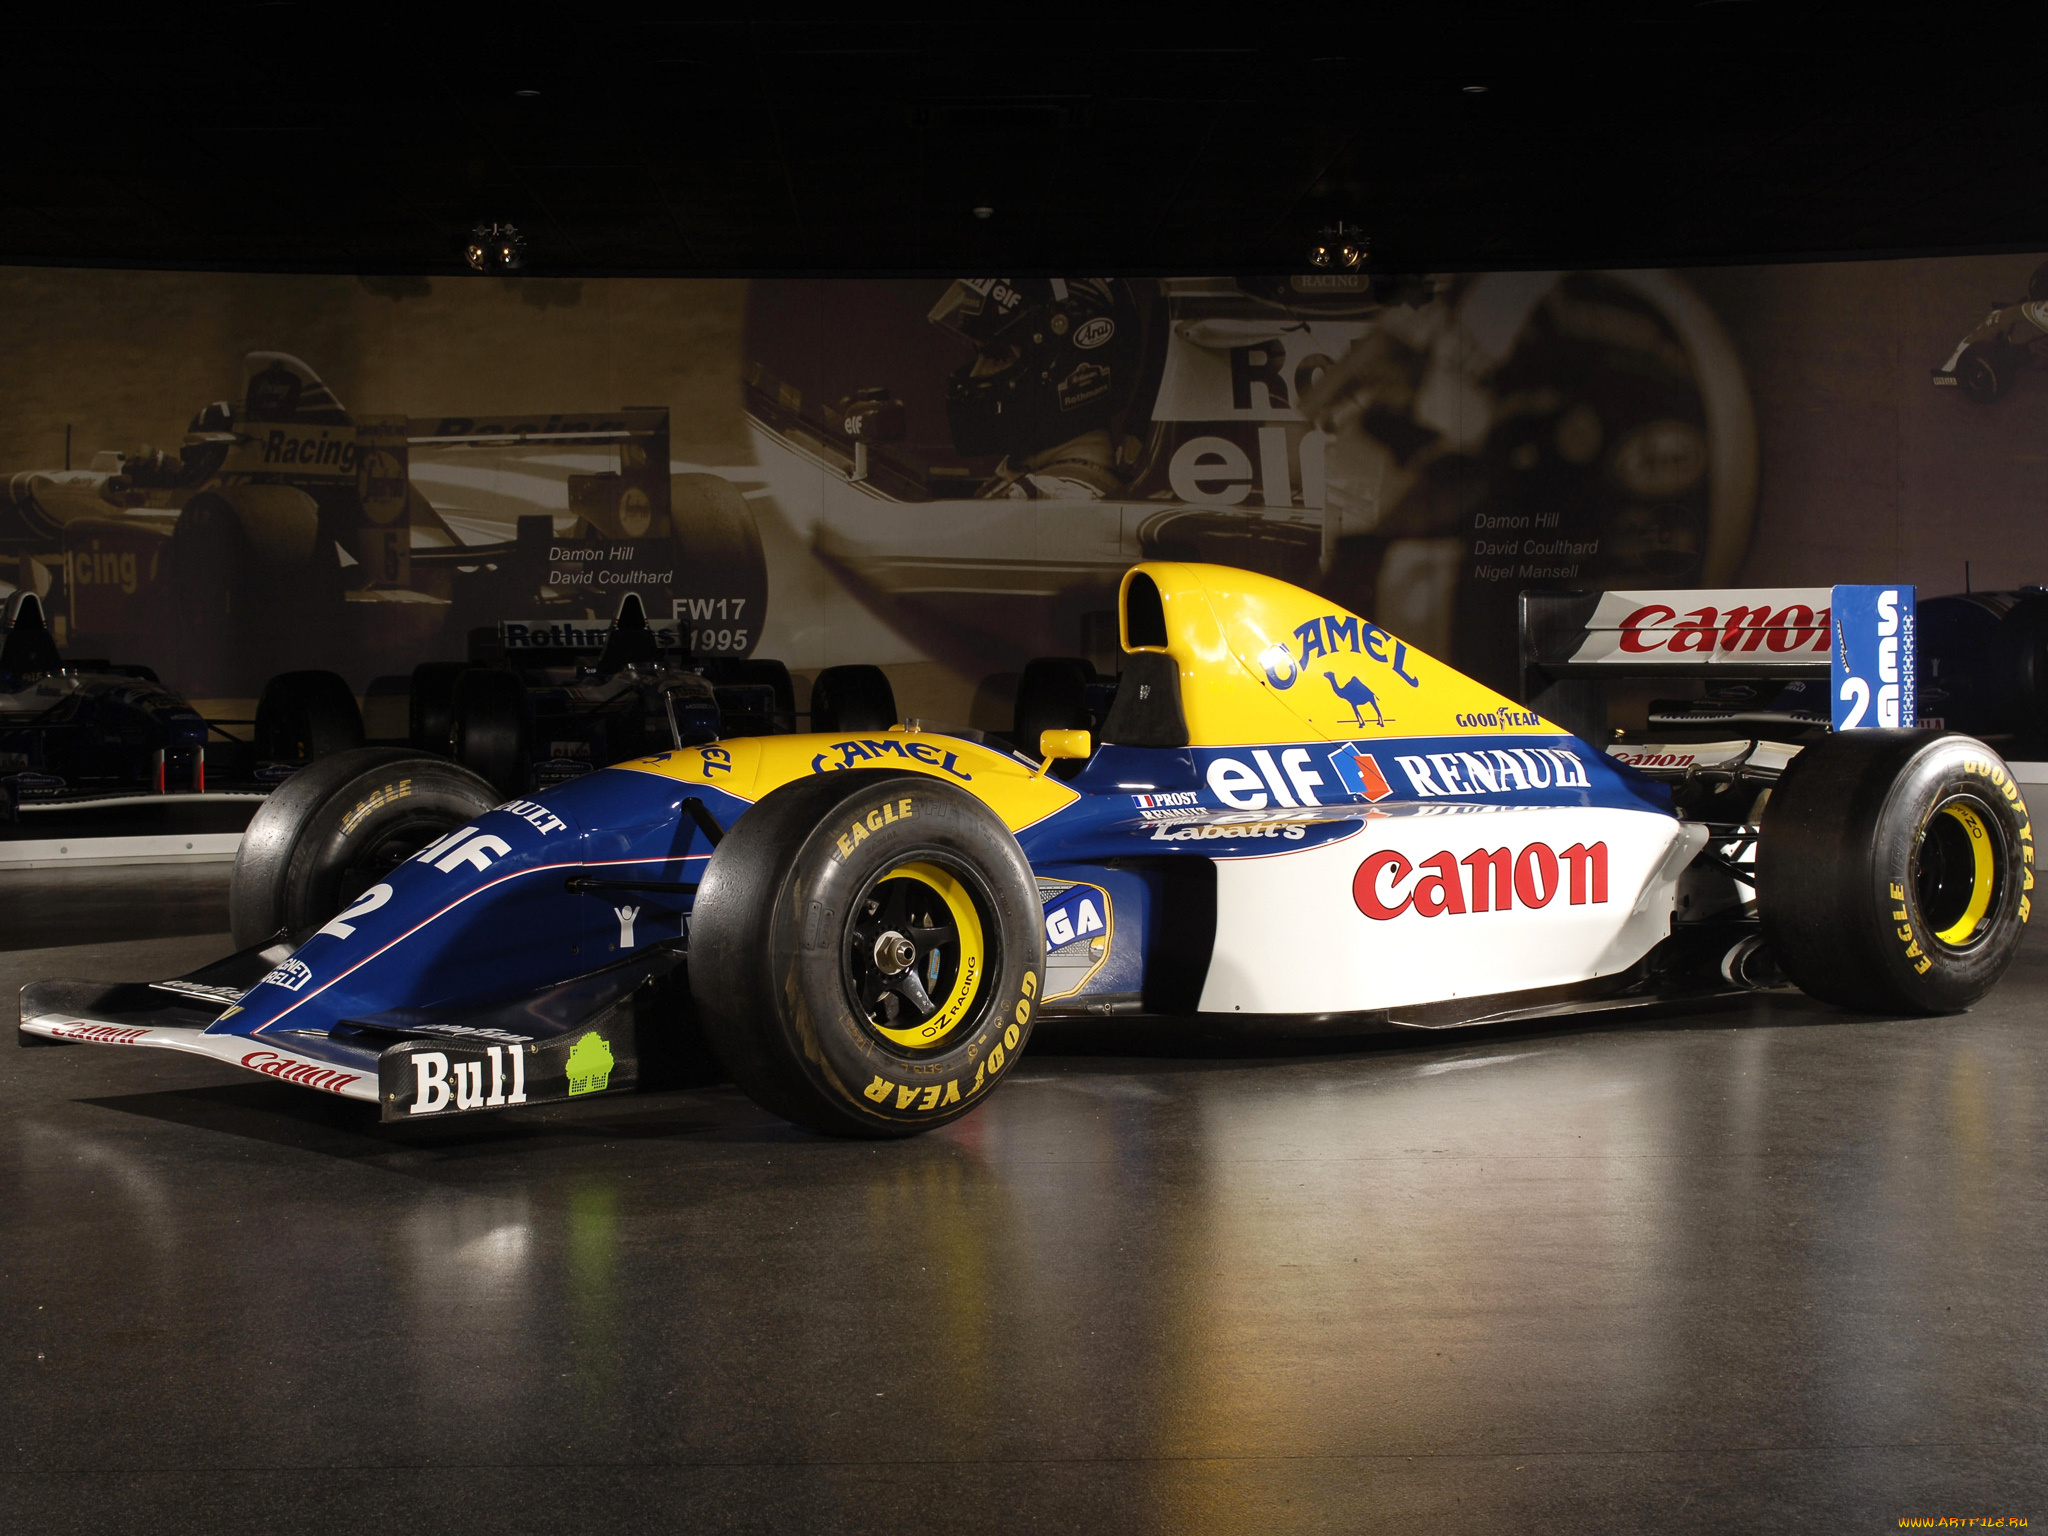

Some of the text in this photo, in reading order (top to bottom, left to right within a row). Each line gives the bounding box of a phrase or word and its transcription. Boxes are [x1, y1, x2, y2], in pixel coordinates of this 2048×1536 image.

[1302, 275, 1359, 287] RACING
[992, 284, 1022, 309] elf
[845, 415, 863, 435] elf
[263, 429, 358, 473] Racing
[1474, 512, 1560, 529] Damon Hill
[549, 546, 635, 561] Damon Hill
[1474, 539, 1599, 555] David Coulthard
[549, 570, 674, 584] David Coulthard
[1474, 565, 1579, 581] Nigel Mansell
[672, 598, 747, 621] FW17
[690, 629, 749, 651] 1995
[1261, 615, 1420, 691] CAMEL
[1839, 676, 1870, 732] 2
[810, 739, 973, 782] CAMEL
[1394, 746, 1592, 798] RENAULT
[1613, 752, 1696, 767] Canon
[1206, 748, 1324, 812] elf
[341, 779, 413, 833] EAGLE
[1152, 791, 1200, 808] PROST
[1140, 806, 1211, 821] RENAULT
[836, 798, 914, 861] EAGLE
[1150, 821, 1308, 842] Labatt's
[1351, 840, 1609, 921] Canon
[318, 883, 394, 940] 2
[1889, 882, 1933, 976] EAGLE
[950, 955, 977, 1016] RACING
[51, 1021, 154, 1044] Canon
[240, 1051, 362, 1094] Canon
[410, 1044, 528, 1115] Bull
